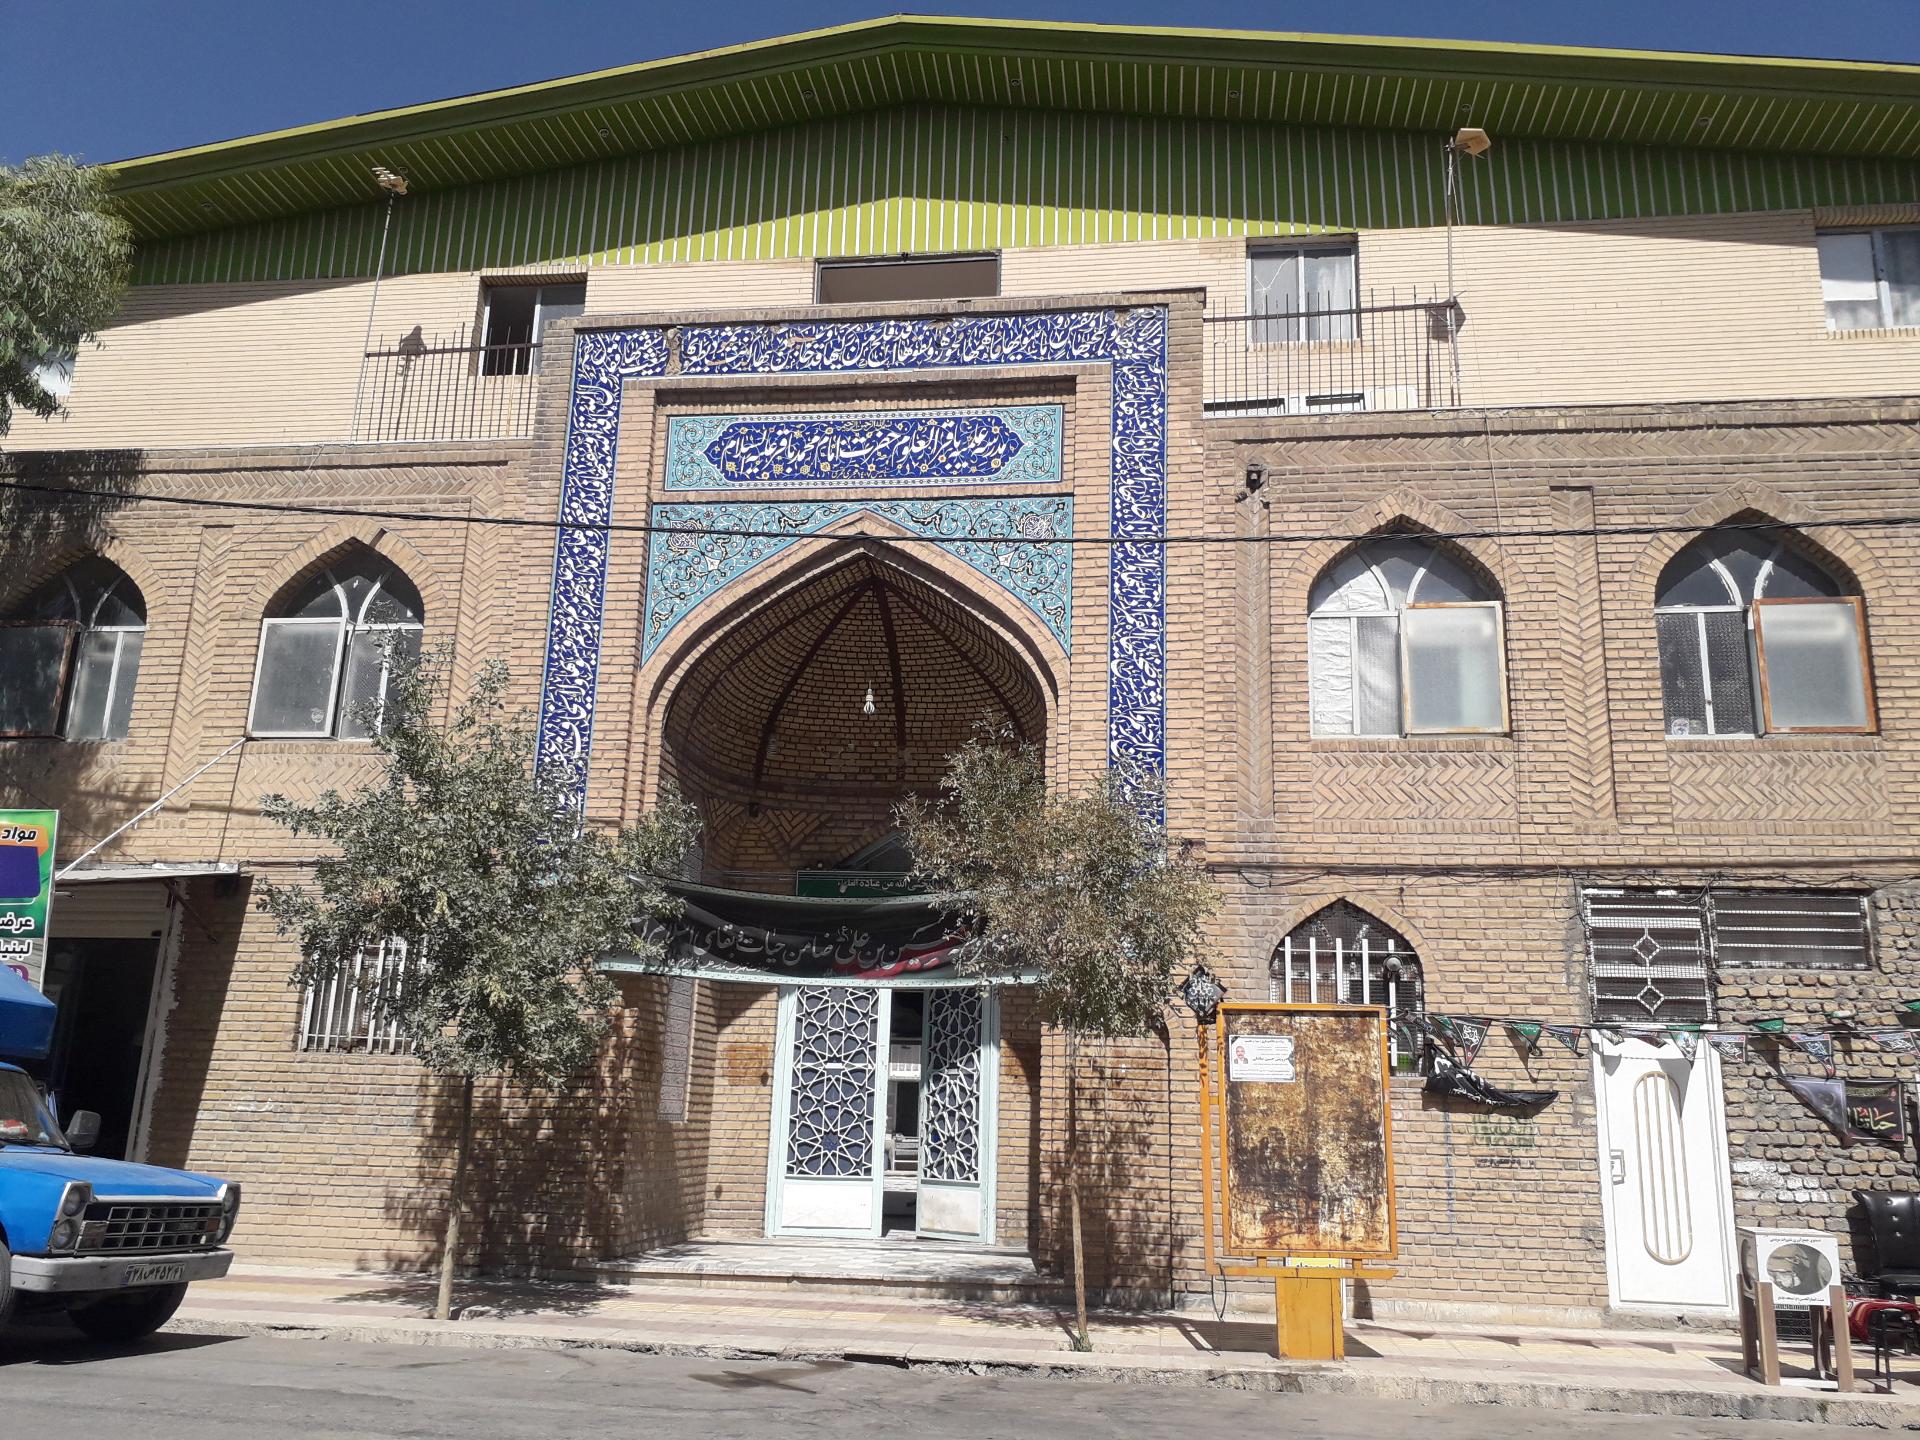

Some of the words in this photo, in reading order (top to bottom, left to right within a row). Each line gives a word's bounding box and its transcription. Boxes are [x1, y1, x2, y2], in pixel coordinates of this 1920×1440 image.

[761, 429, 794, 473] باقر
[786, 435, 821, 465] محمد
[840, 430, 901, 466] حضرت
[971, 434, 1007, 458] مدرسه
[1, 826, 37, 842] مواد
[0, 913, 34, 933] عرض
[0, 940, 32, 960] لبنیا
[782, 932, 834, 967] ضامن
